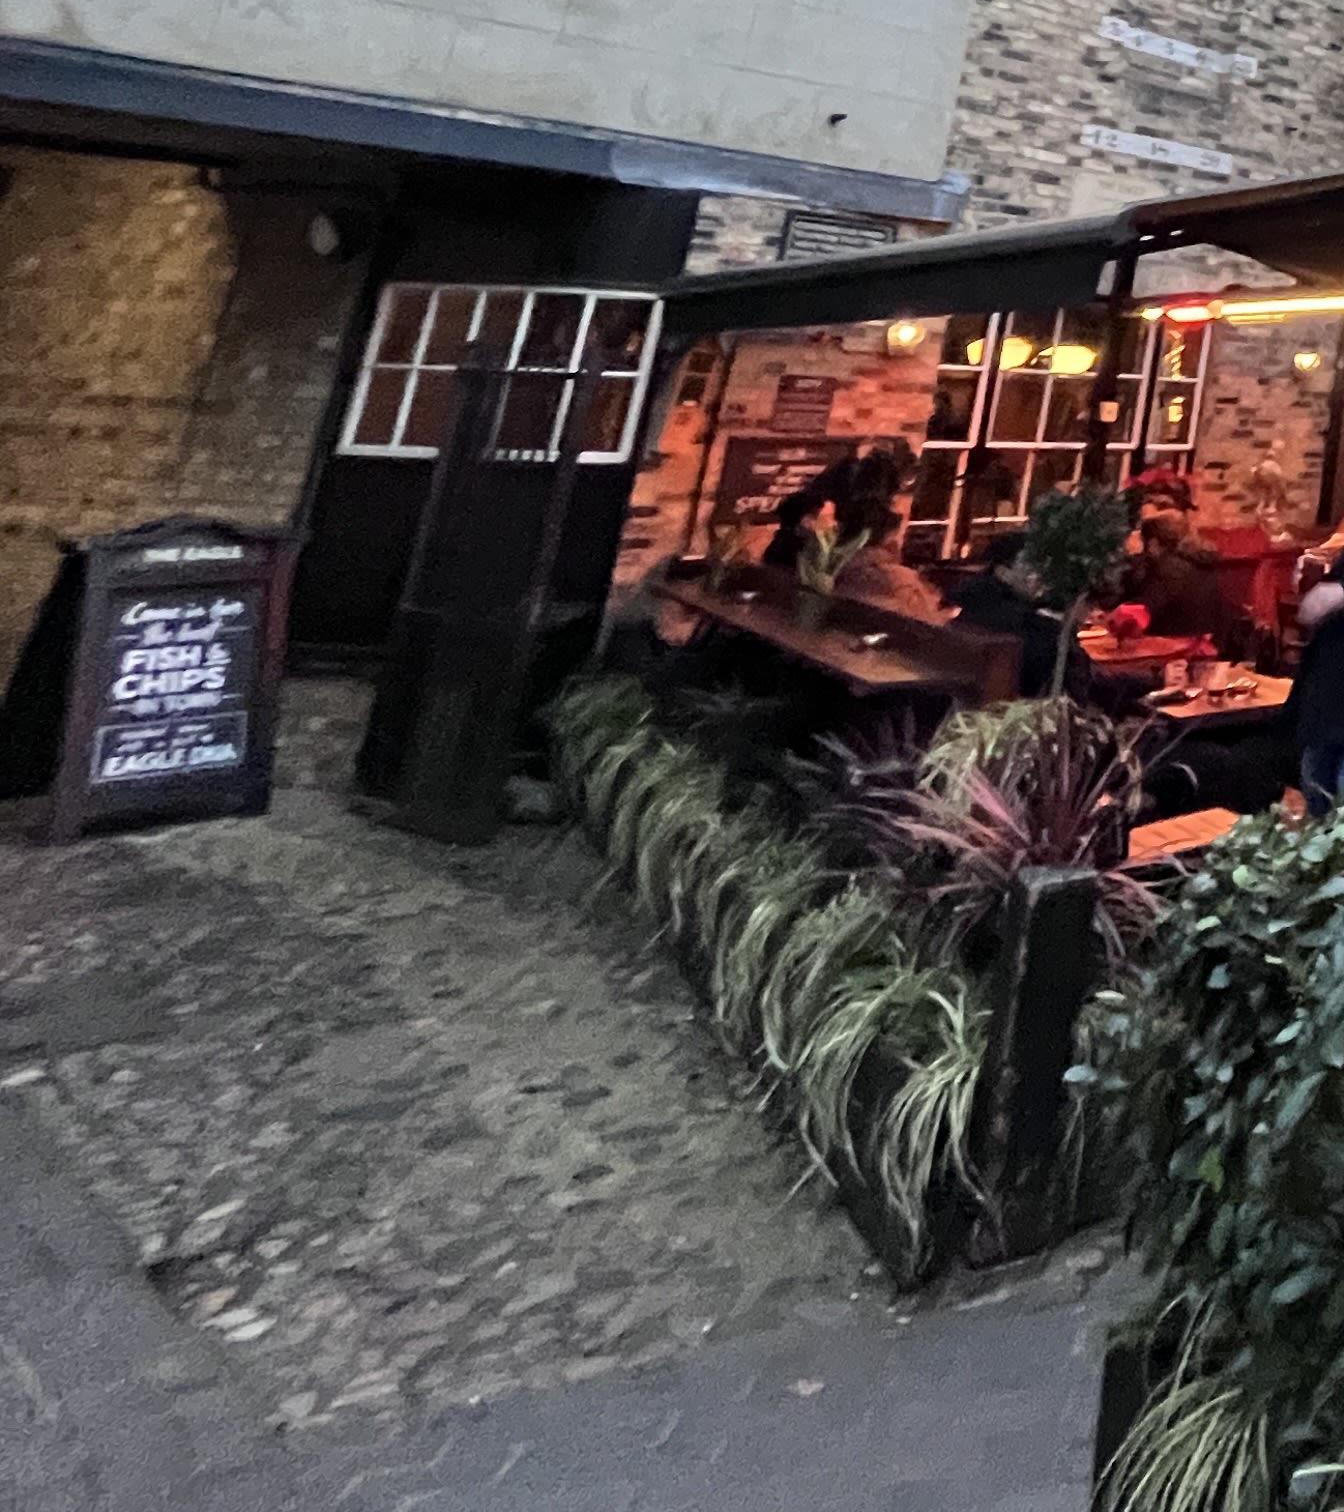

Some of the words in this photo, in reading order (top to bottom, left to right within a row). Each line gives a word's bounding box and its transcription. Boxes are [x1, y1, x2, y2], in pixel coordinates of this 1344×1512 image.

[122, 646, 202, 673] FISH
[203, 642, 232, 666] &
[112, 666, 227, 701] CHIPS
[101, 748, 187, 777] EAGLE
